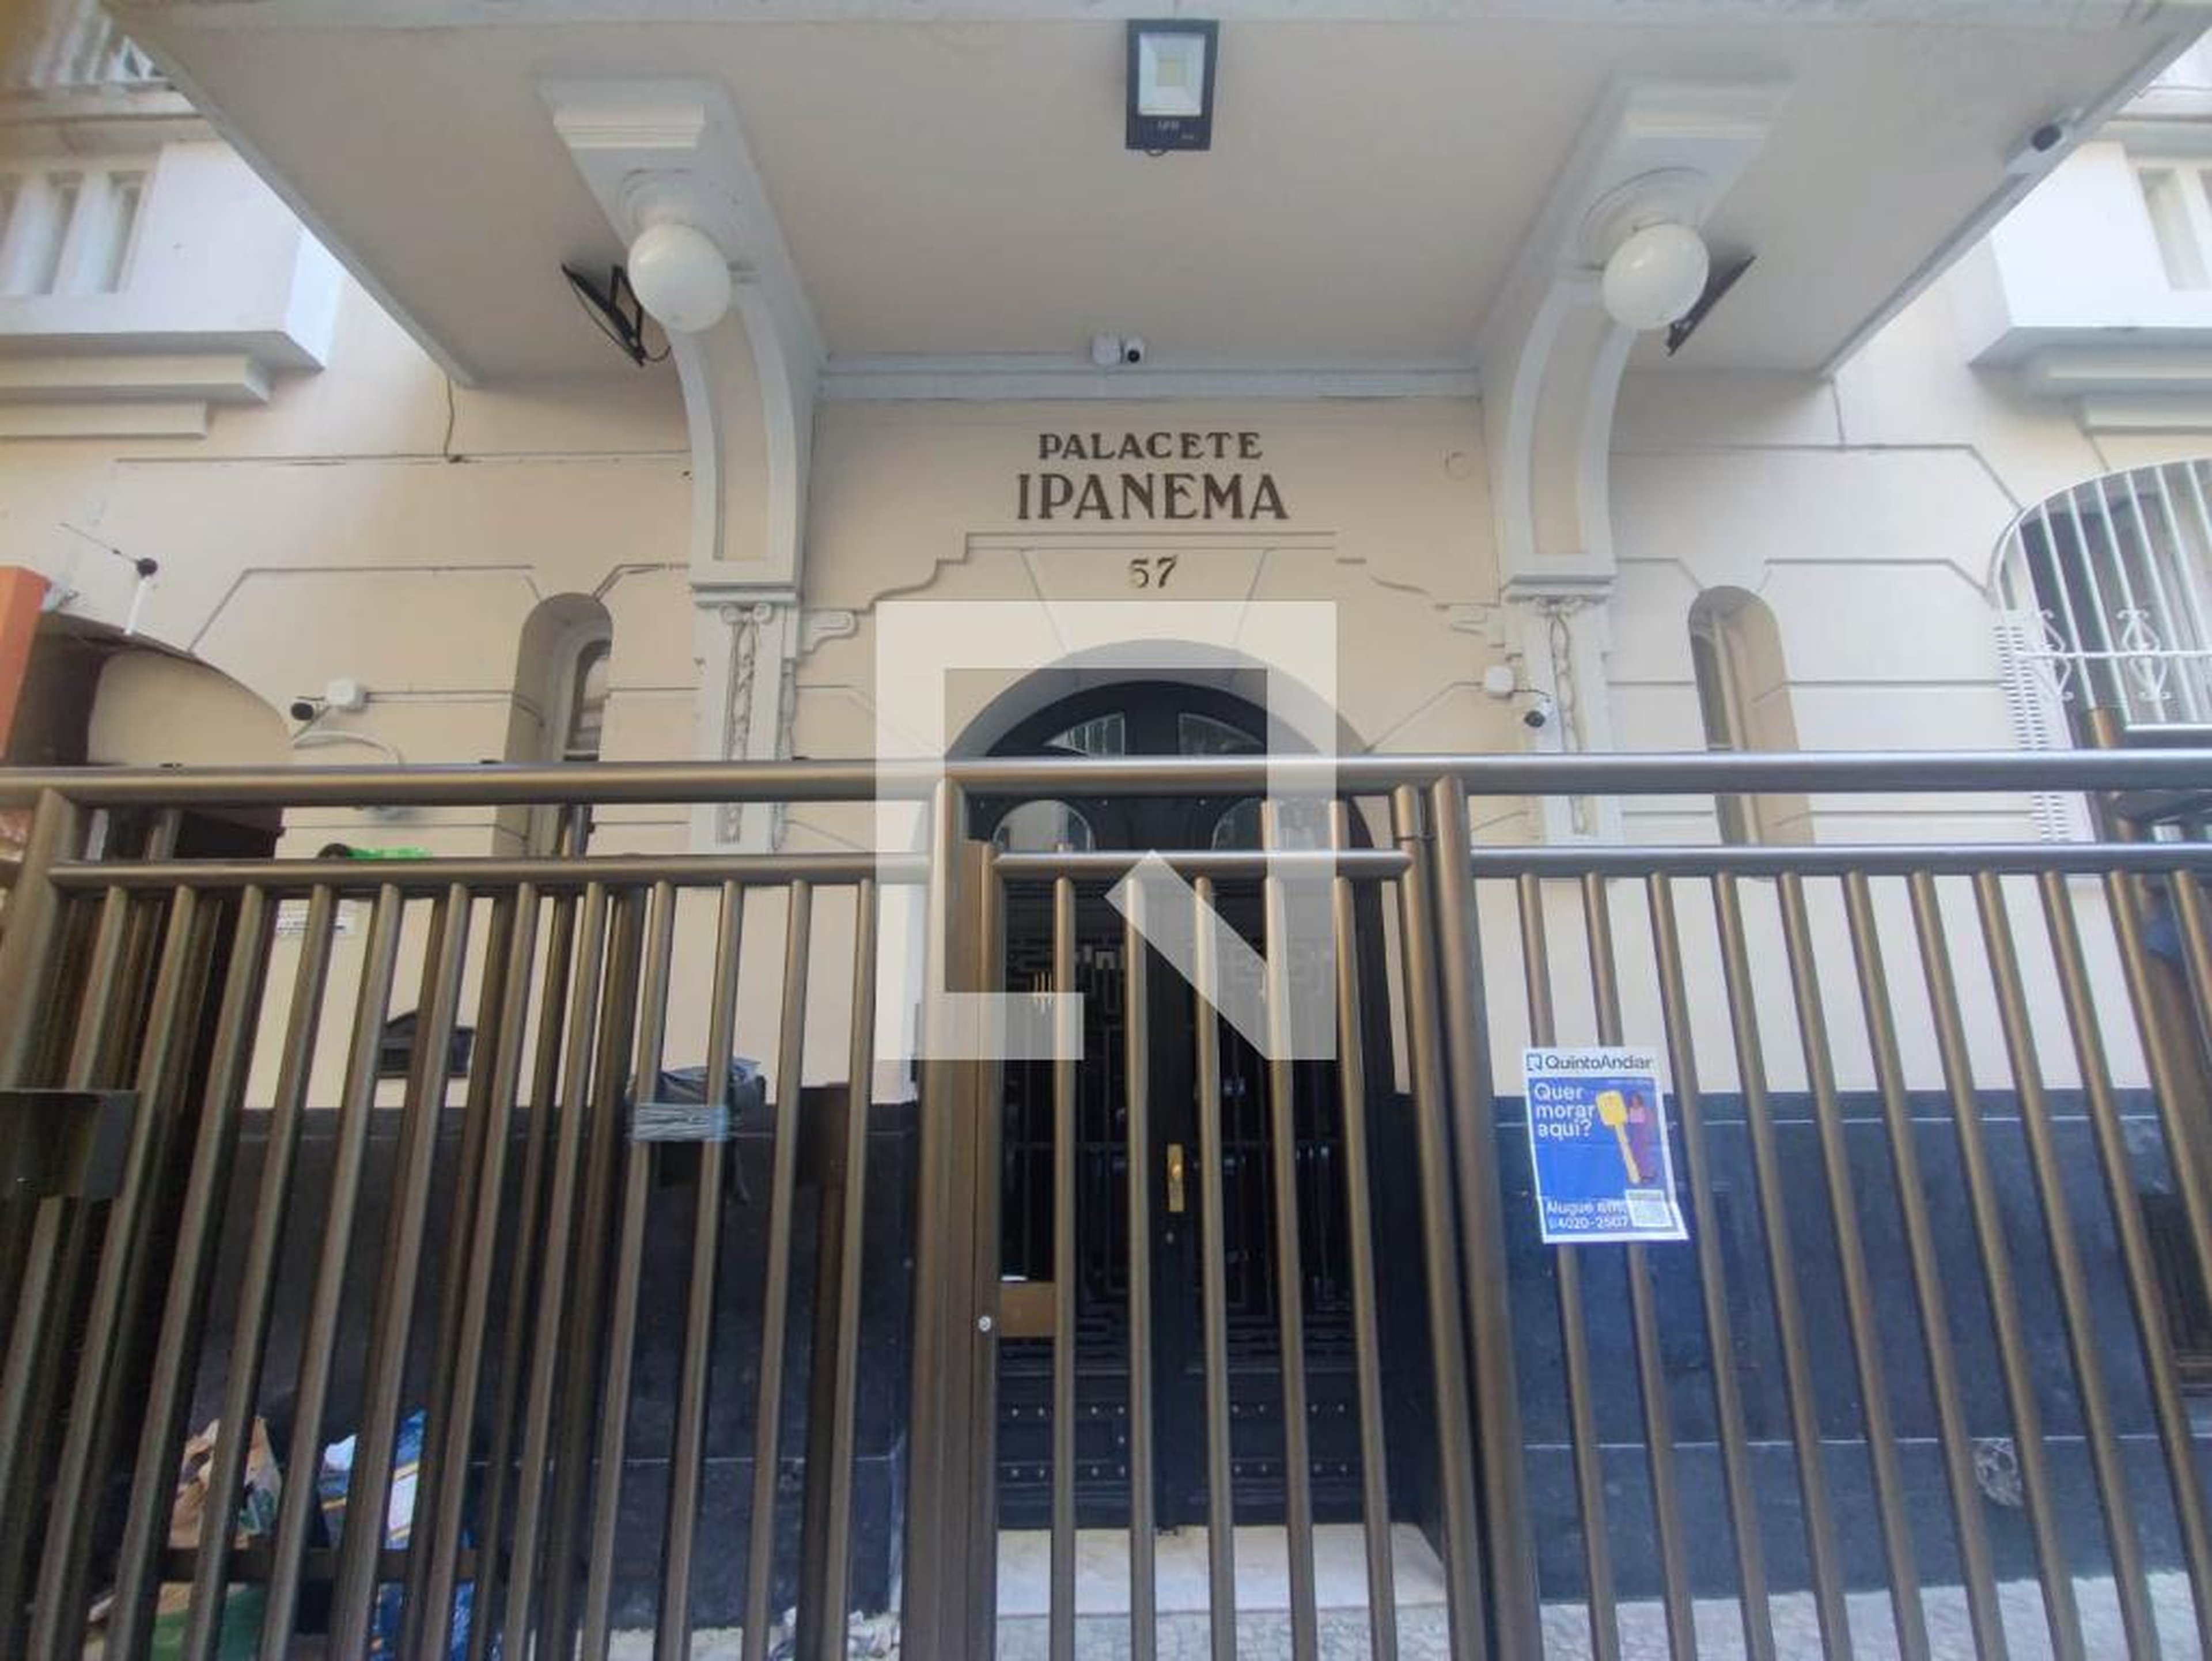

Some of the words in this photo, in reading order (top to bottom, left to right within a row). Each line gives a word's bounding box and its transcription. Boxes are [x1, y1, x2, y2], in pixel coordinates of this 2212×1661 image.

[1039, 432, 1263, 460] PALACETE
[1017, 474, 1289, 519] IPANEMA
[1129, 555, 1177, 588] 57
[1546, 1055, 1652, 1070] QuintoAndar
[1535, 1083, 1582, 1101] Quer
[1536, 1104, 1595, 1119] morar
[1539, 1119, 1592, 1140] aqui?
